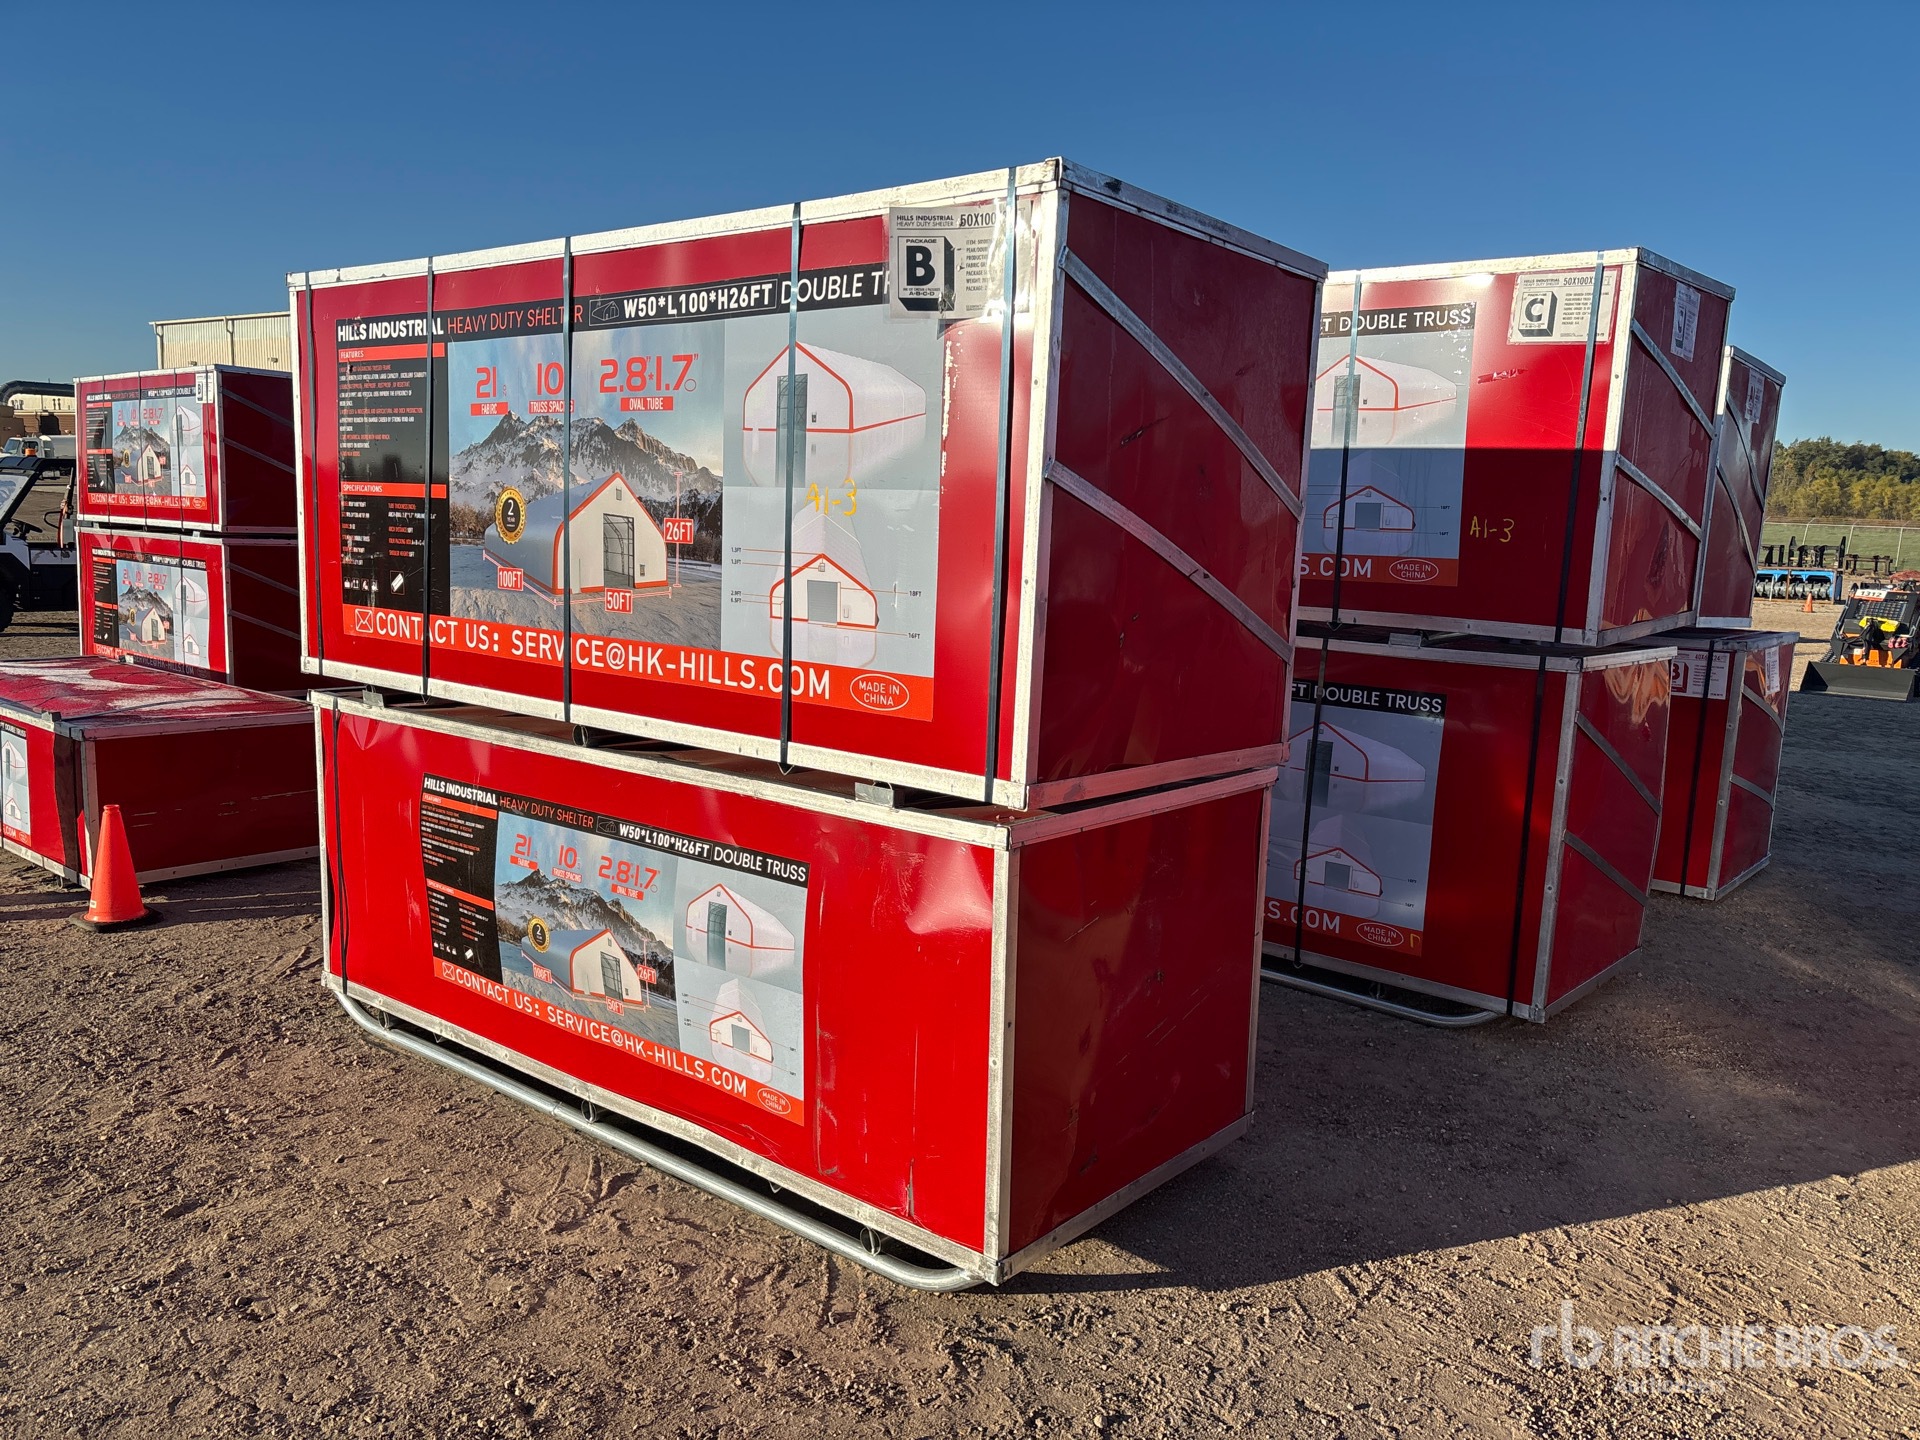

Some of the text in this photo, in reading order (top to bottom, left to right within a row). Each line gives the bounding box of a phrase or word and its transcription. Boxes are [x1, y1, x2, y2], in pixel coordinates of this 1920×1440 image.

[906, 245, 936, 287] B
[338, 323, 367, 342] HILLS
[447, 314, 487, 334] HEAVY
[490, 310, 524, 330] DUTY
[527, 304, 583, 328] SHELTR
[780, 272, 864, 304] DOUBLE
[1525, 297, 1545, 322] C
[1339, 308, 1471, 332] DOUBLE TRUSS
[340, 350, 364, 359] FEATURES
[476, 366, 497, 399] 21
[537, 362, 564, 396] 10
[530, 400, 574, 413] TRUSS SPACIG
[629, 397, 664, 411] OVAL TUBE
[343, 484, 383, 493] SPECIFICATIONS
[507, 499, 514, 515] 2
[666, 520, 693, 542] 26FT
[181, 560, 196, 568] OUBLE
[1396, 563, 1431, 572] MADE IN
[499, 568, 523, 589] 100FT
[1401, 571, 1426, 579] CHINA
[607, 591, 632, 611] 50FT
[100, 647, 122, 658] CONTCT
[465, 623, 499, 652] US:
[511, 629, 830, 700] SERVCE@HK-HILLS.COM
[859, 680, 900, 695] MADE IN
[863, 693, 894, 706] CHINA
[1314, 685, 1380, 706] DOUBLE
[1385, 693, 1442, 713] TRUSS
[424, 777, 446, 793] HILLS
[446, 782, 498, 806] INDUSTRIAL
[499, 795, 529, 814] HEAVY
[531, 802, 556, 819] DUTY
[556, 808, 594, 829] SHELTER
[714, 847, 762, 872] DOUBLE
[766, 858, 806, 882] TRUSS
[514, 833, 532, 857] 21
[558, 844, 578, 869] 10
[1363, 925, 1397, 938] MADE IN
[1367, 933, 1392, 945] CHINA
[639, 968, 656, 983] 26FT
[455, 968, 509, 1004] CONTACT
[514, 995, 540, 1016] US:
[547, 1006, 747, 1098] SERVICE@HK-HILLS.COM
[762, 1091, 786, 1106] MADE IN
[765, 1099, 783, 1112] CHINA
